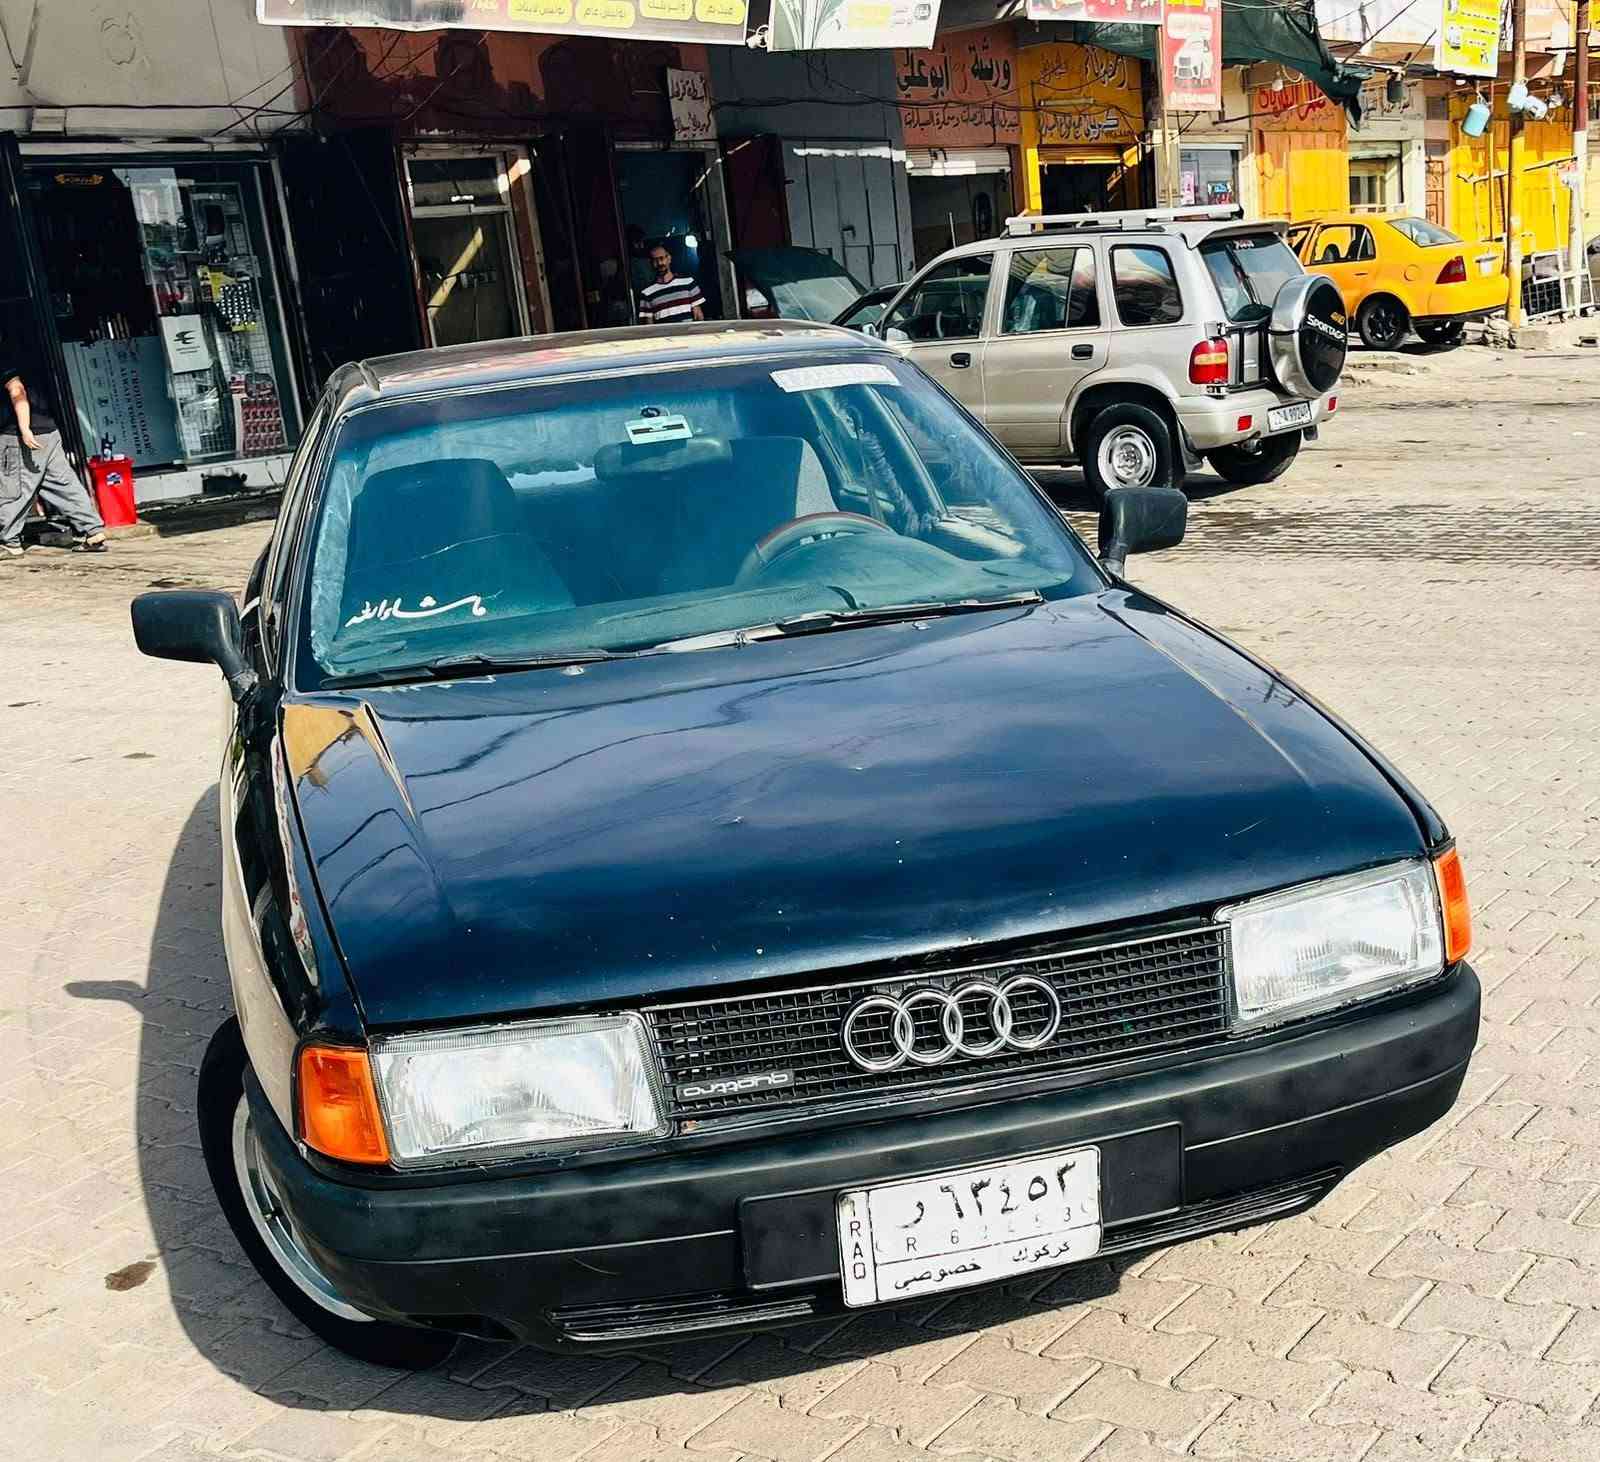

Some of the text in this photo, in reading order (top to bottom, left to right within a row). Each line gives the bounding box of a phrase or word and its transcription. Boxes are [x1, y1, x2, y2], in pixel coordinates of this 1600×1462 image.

[682, 1073, 788, 1097] quattro
[893, 1240, 1071, 1292] كركوك خصوصي
